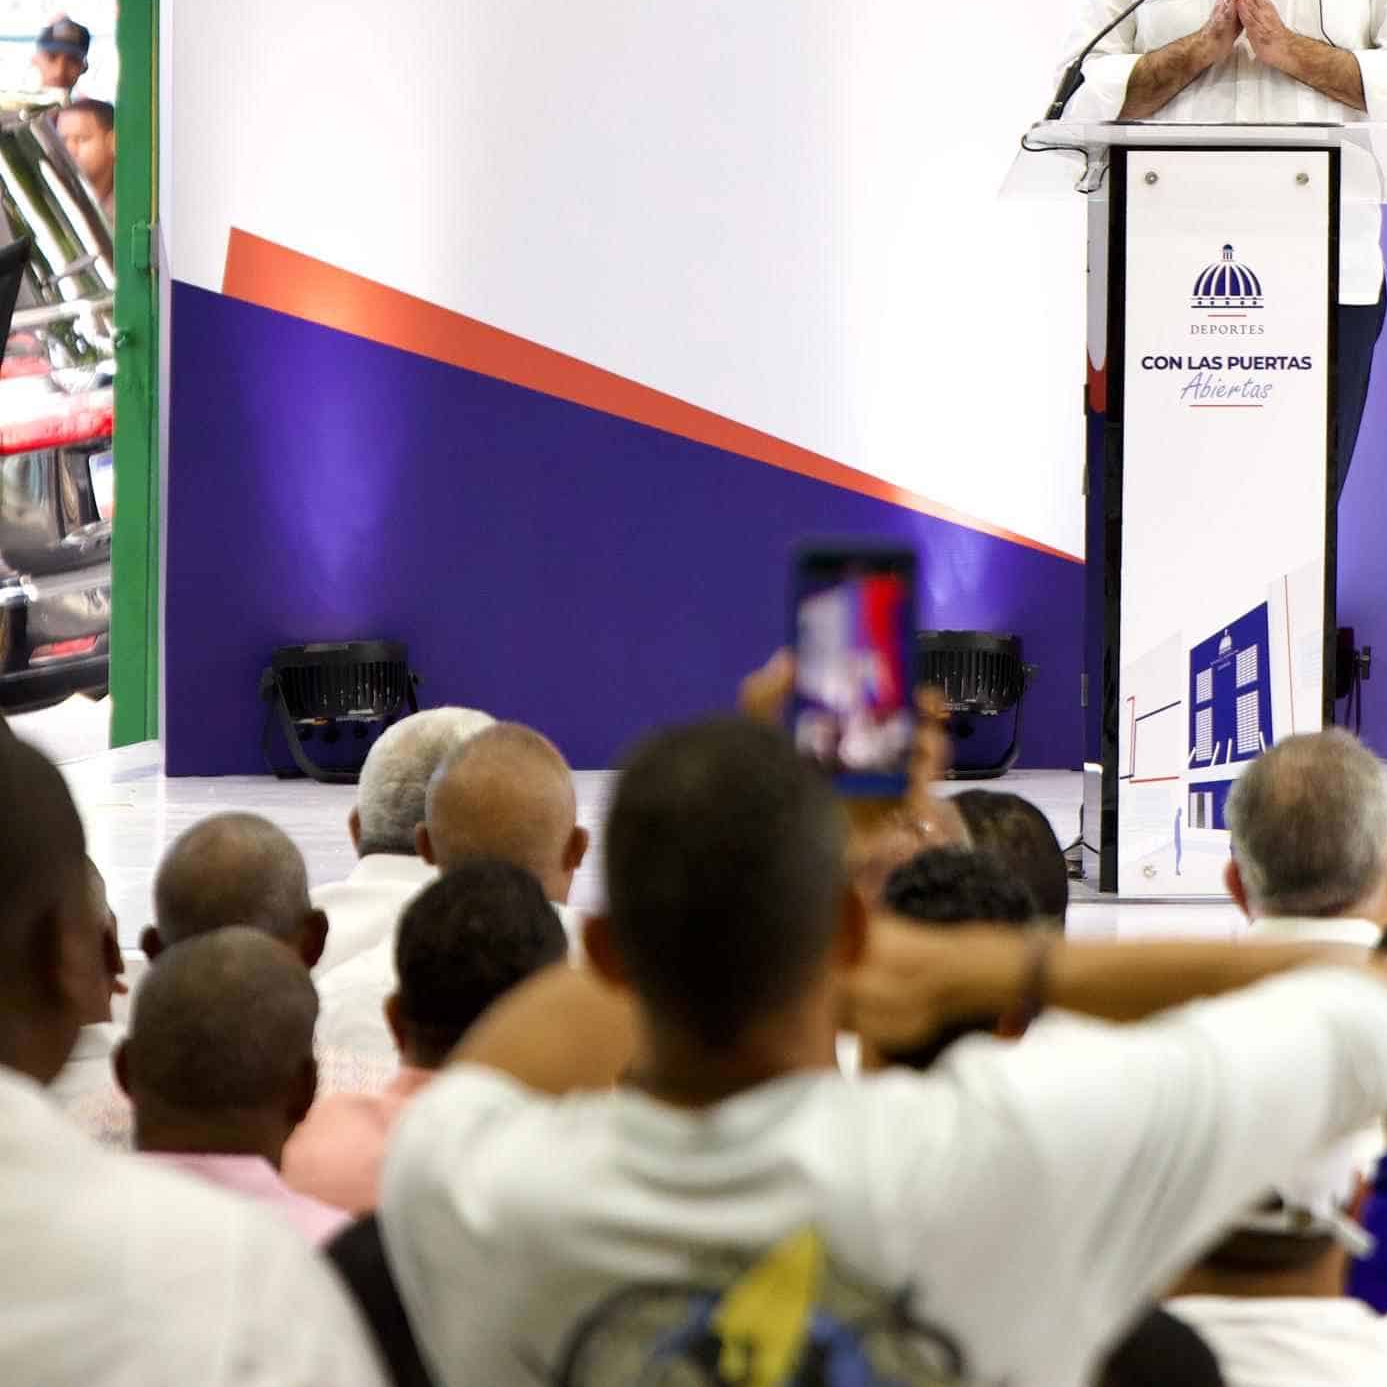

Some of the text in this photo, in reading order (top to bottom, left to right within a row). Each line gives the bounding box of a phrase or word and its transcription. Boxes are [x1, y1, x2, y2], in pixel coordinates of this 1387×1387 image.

[1190, 324, 1265, 336] DEPORTES
[1141, 355, 1313, 371] CON LAS PUERTAS
[1180, 371, 1273, 401] Abiertas
